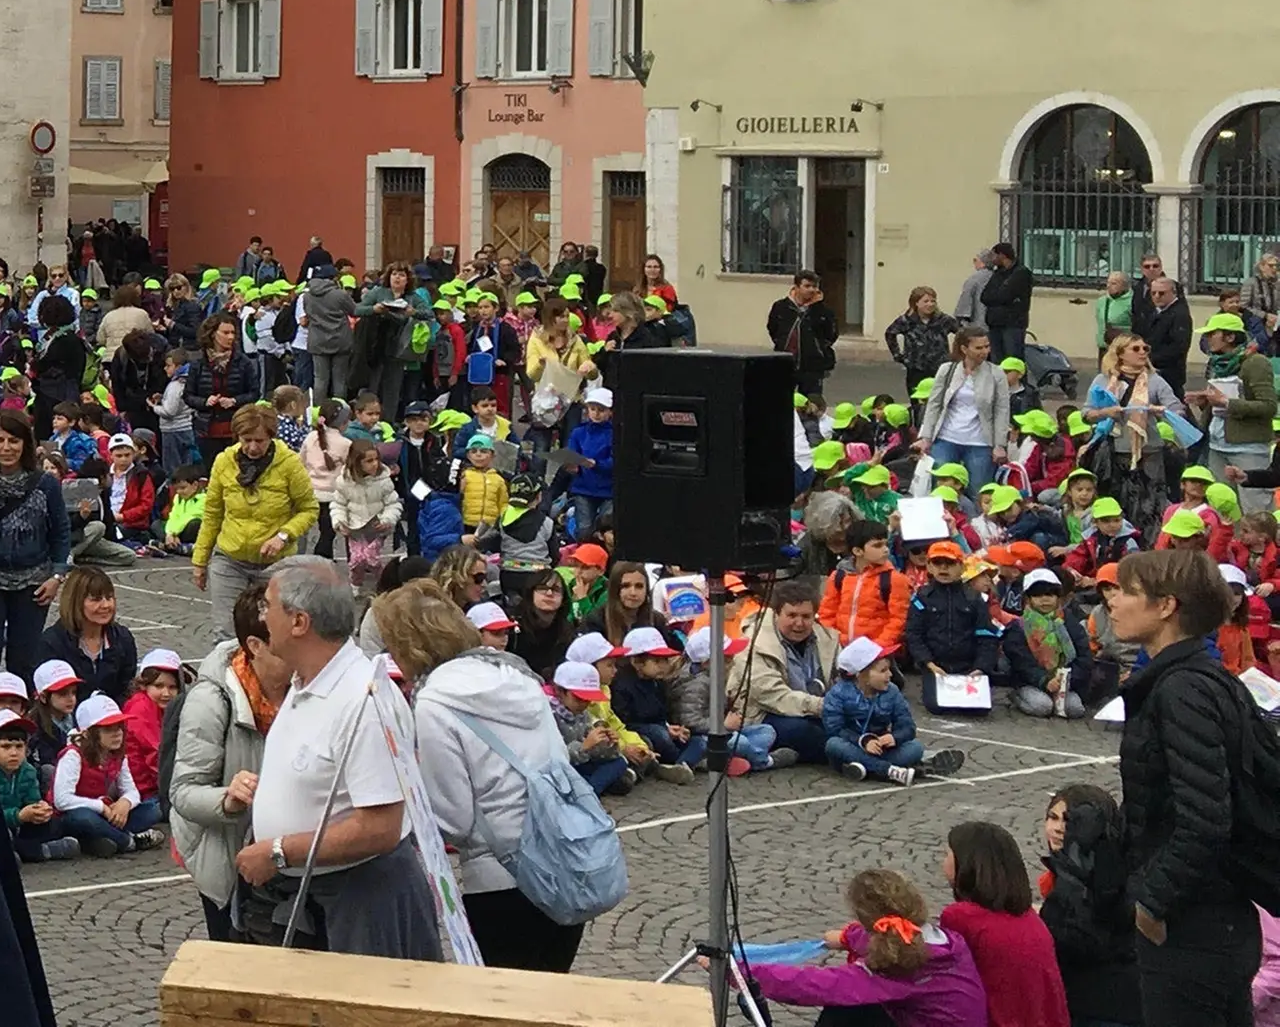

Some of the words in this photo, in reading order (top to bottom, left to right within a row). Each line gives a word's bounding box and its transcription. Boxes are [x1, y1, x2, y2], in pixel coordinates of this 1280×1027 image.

[504, 93, 527, 107] TIKI
[488, 109, 525, 125] Lounge
[527, 109, 545, 122] Bar
[736, 116, 859, 134] GIOIELLERIA
